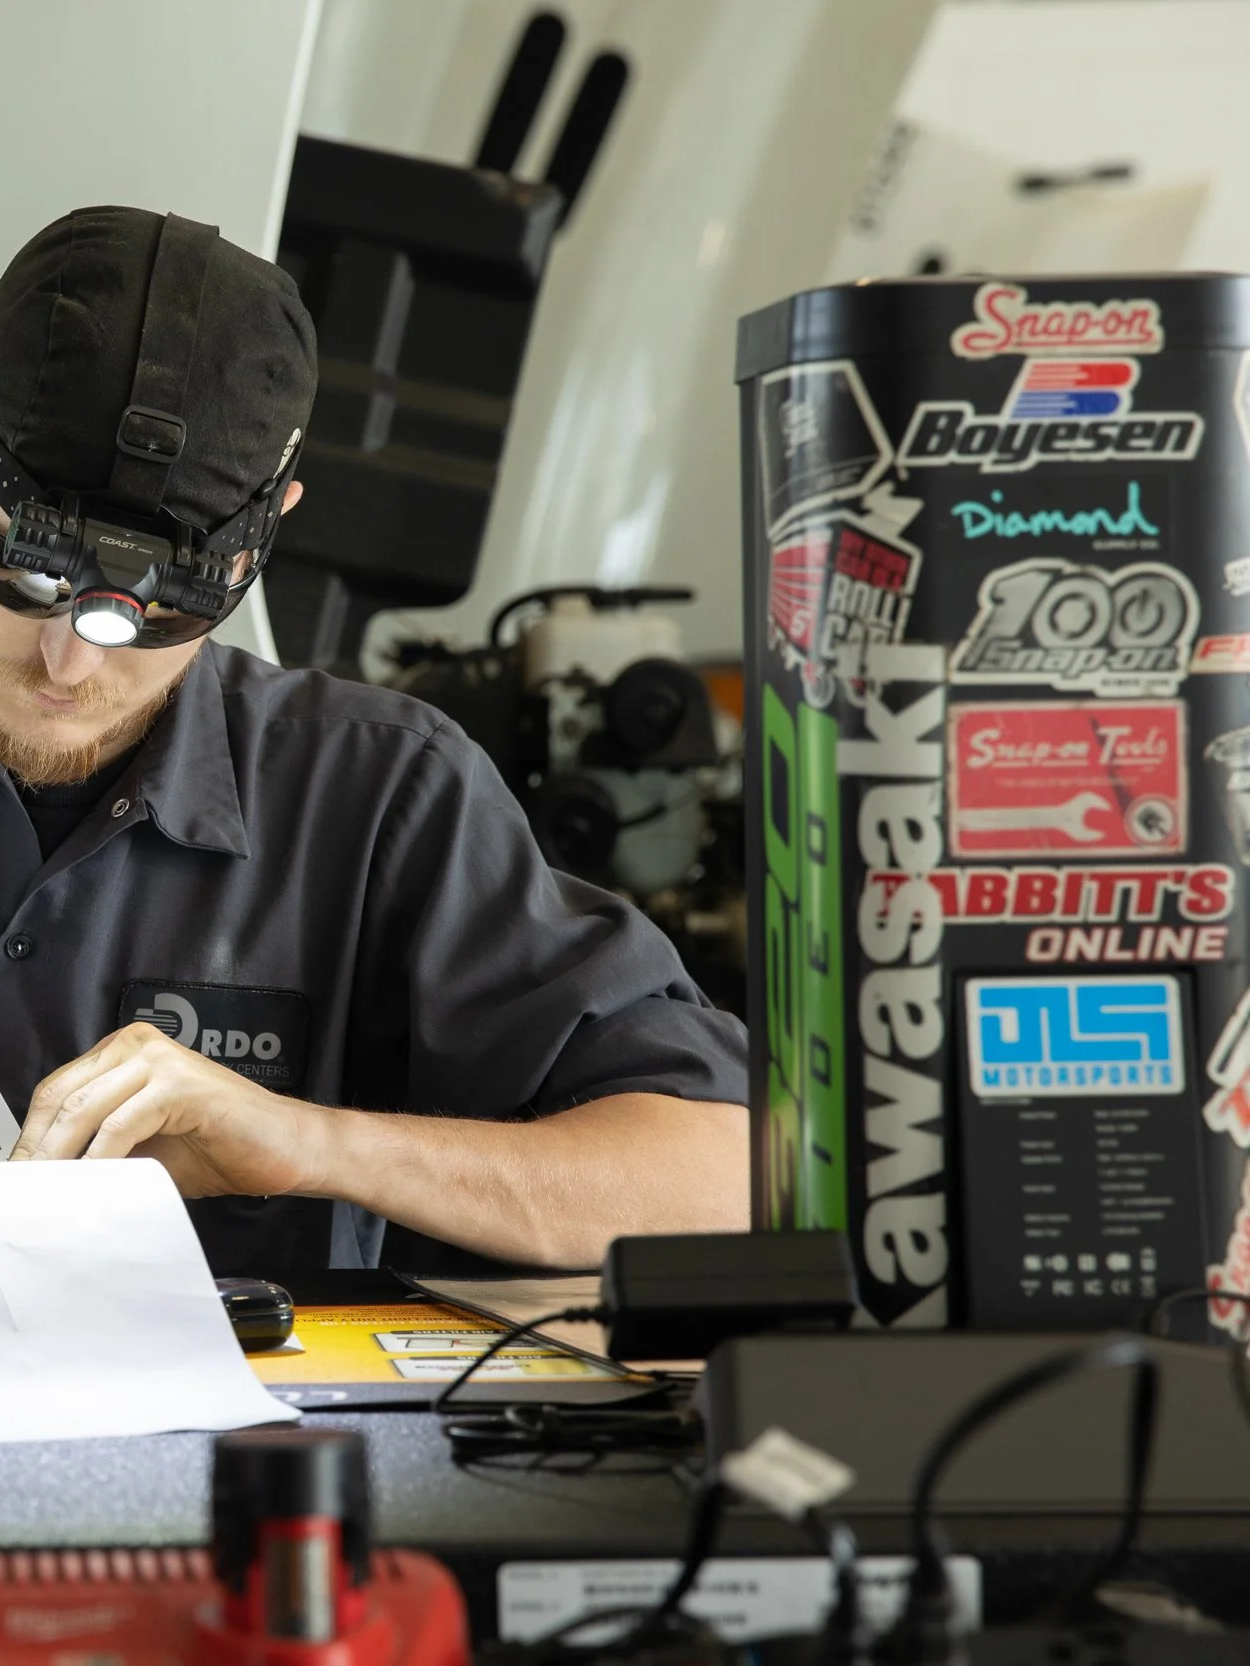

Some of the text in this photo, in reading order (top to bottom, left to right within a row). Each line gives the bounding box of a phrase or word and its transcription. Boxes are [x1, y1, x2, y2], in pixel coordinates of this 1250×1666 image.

[961, 290, 1156, 352] Snap-on
[906, 406, 1198, 468] Boyesen
[951, 481, 1159, 539] Diamond
[99, 536, 137, 550] COAST
[990, 567, 1186, 648] 100
[966, 725, 1169, 768] Snap-on Tools
[1026, 927, 1228, 962] ONLINE
[200, 1029, 282, 1060] RDO
[237, 1063, 290, 1077] CENTERS
[982, 1064, 1173, 1087] MOTORSPORTS
